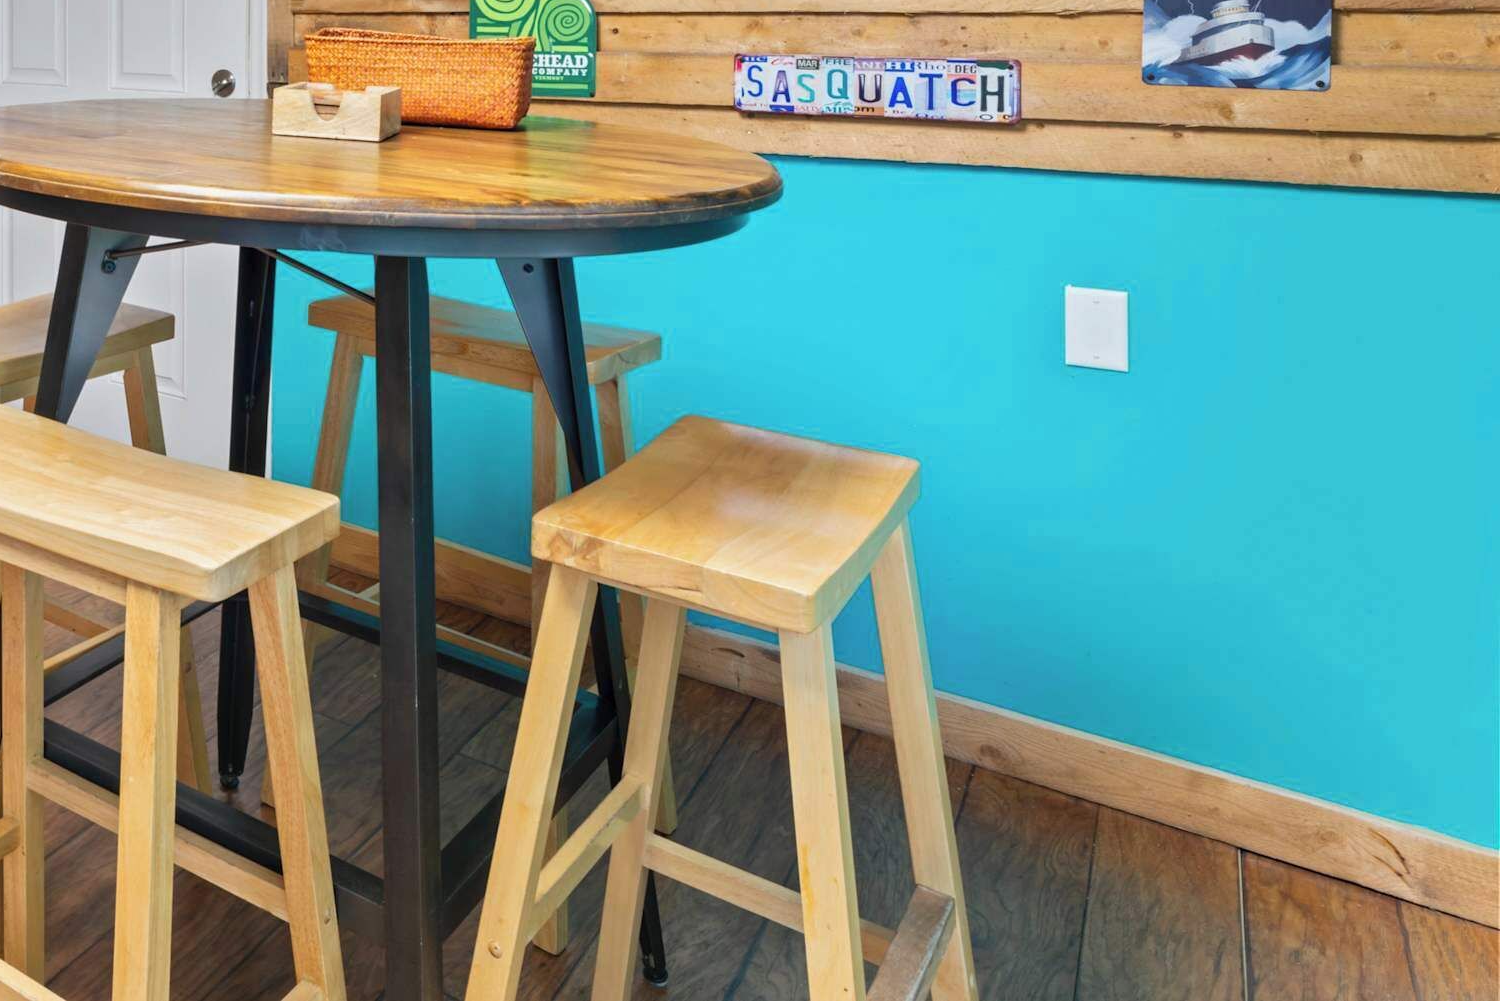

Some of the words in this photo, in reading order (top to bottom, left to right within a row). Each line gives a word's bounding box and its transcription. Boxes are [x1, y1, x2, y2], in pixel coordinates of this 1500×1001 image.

[797, 59, 818, 67] MAR
[532, 68, 588, 77] COMPANY
[954, 64, 977, 74] DEC
[747, 64, 1005, 113] SASQUATCH
